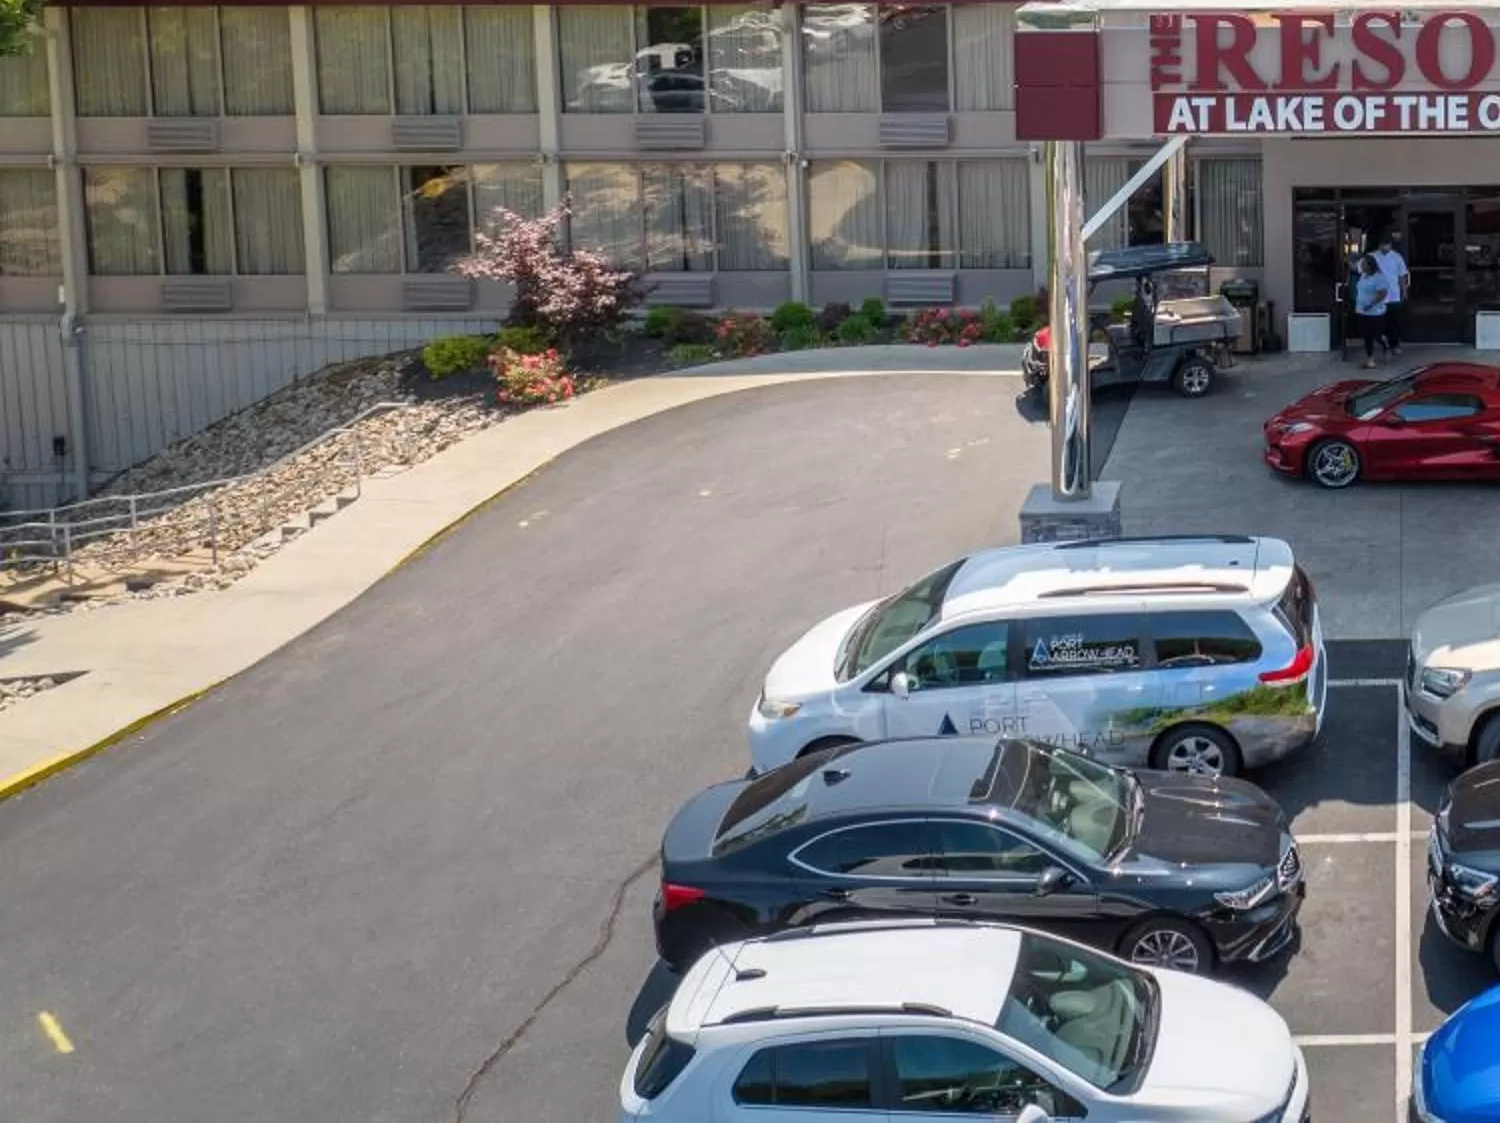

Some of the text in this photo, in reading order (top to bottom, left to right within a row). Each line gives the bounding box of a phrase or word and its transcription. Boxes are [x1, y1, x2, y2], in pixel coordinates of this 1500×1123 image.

[1150, 13, 1182, 91] THE
[1167, 96, 1216, 131] AT
[1224, 96, 1325, 131] LAKE
[1333, 95, 1386, 130] OF
[1393, 94, 1469, 129] THE
[1050, 636, 1084, 650] PORT
[1052, 644, 1135, 662] ARROWHEAD
[969, 715, 1029, 734] PORT
[1029, 730, 1125, 749] WHEAD
